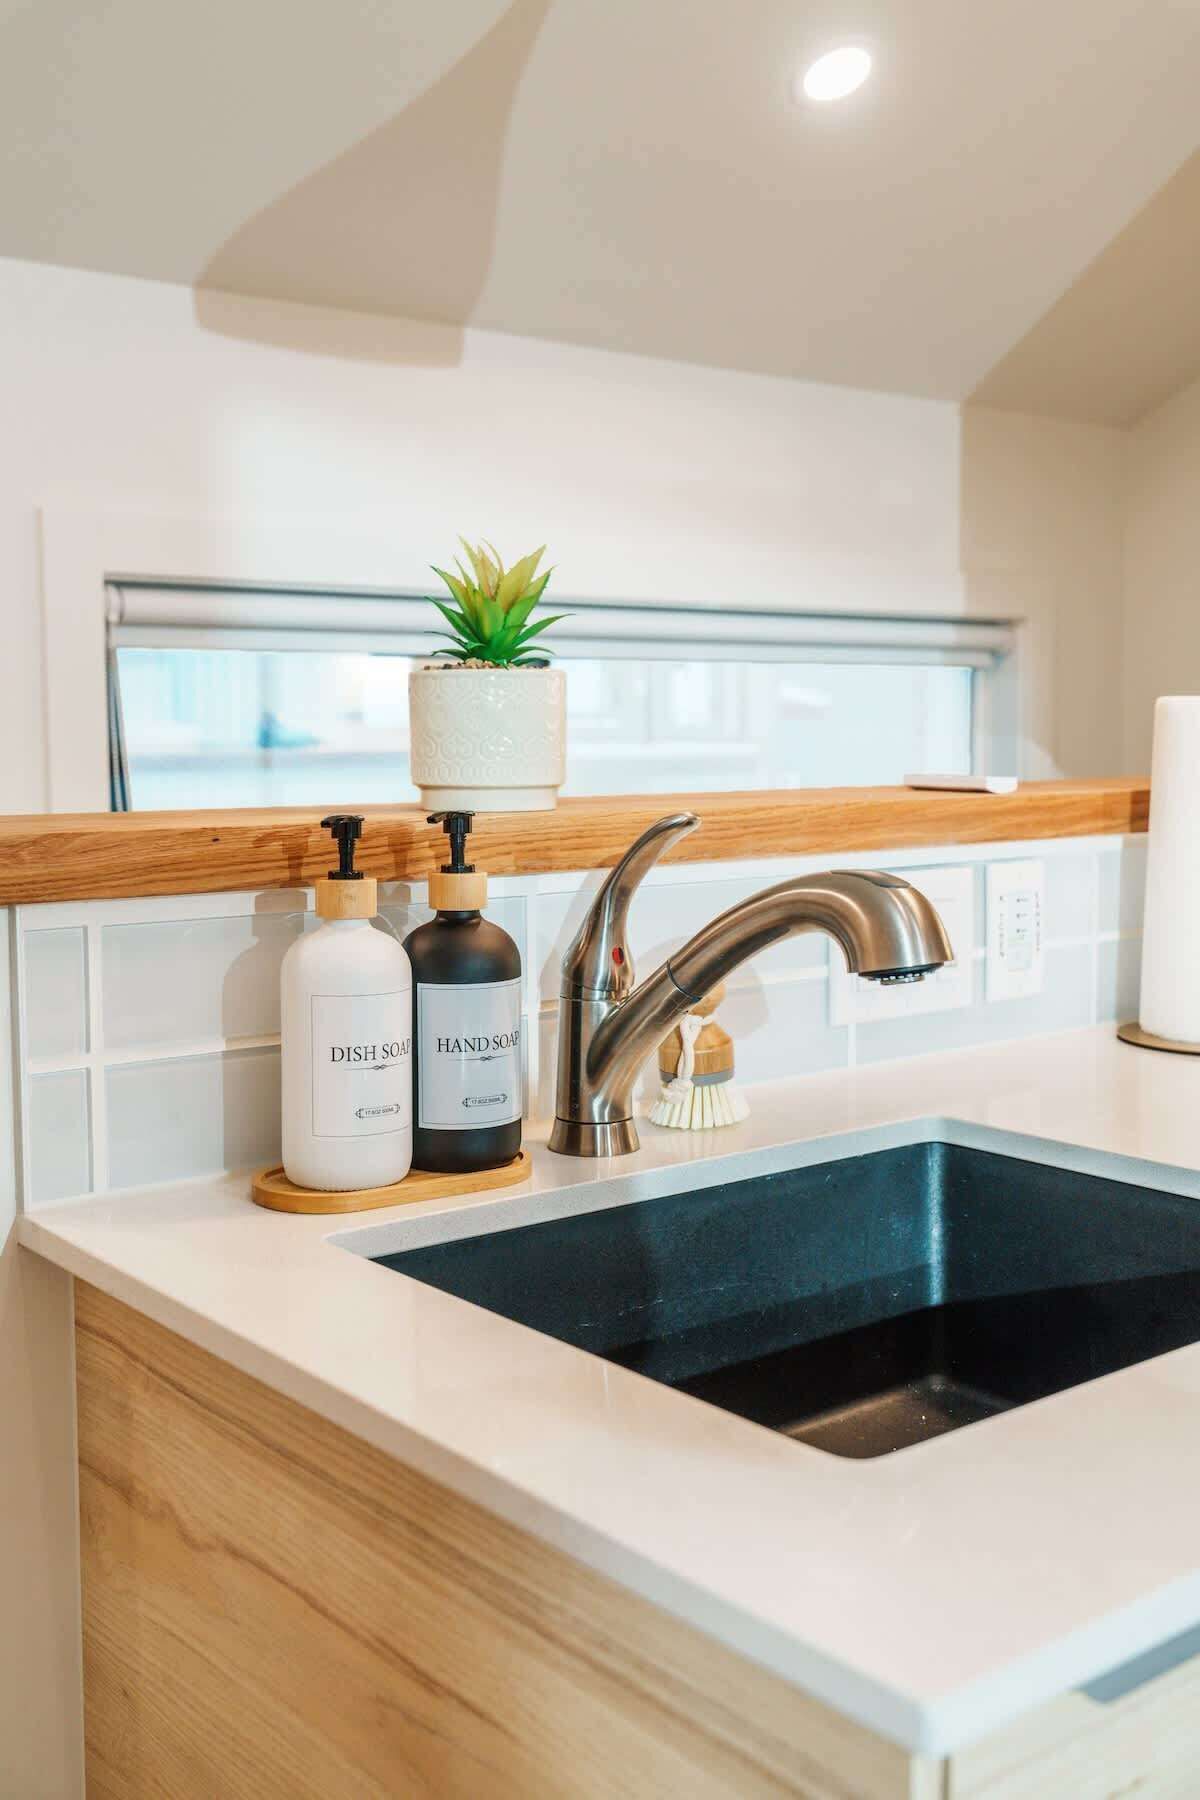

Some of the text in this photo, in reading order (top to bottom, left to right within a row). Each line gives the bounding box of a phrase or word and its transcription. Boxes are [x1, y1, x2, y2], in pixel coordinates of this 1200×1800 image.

[331, 1038, 411, 1062] DISH SOAP
[437, 1030, 520, 1053] HAND SOAP
